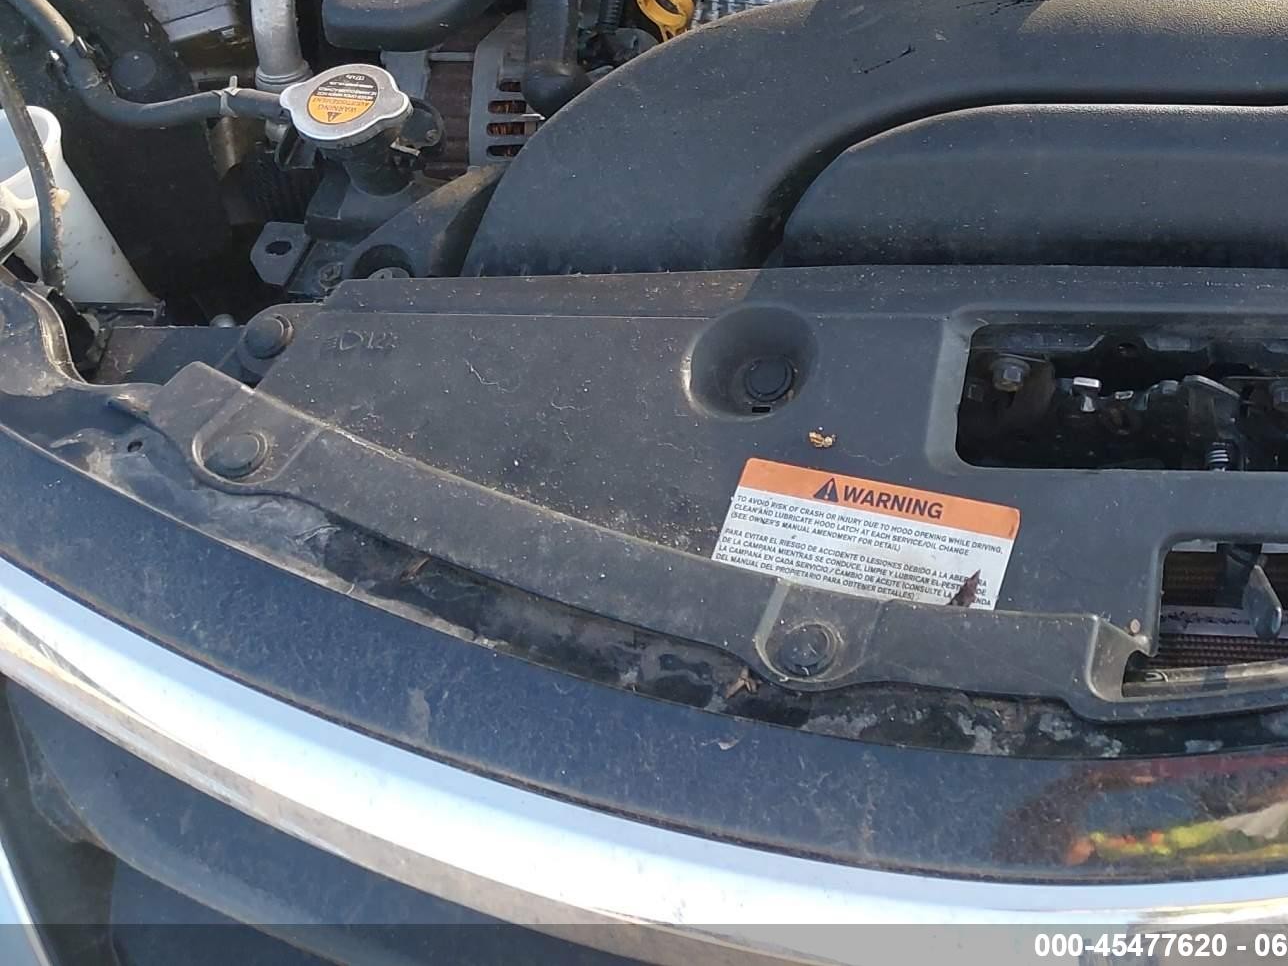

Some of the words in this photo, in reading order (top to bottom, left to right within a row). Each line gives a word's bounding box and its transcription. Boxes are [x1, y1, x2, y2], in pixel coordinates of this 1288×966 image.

[317, 104, 356, 112] WARNING
[748, 498, 769, 506] AVOID
[771, 502, 787, 510] RISK
[800, 508, 824, 517] CRASH
[838, 515, 861, 524] INJURY
[864, 520, 878, 528] DUE
[891, 525, 913, 535] HOOD
[914, 530, 947, 541] OPENING
[949, 537, 970, 546] WHILE
[844, 485, 944, 520] WARNING
[731, 512, 747, 520] (SEE
[782, 522, 810, 532] MANUAL
[813, 528, 856, 542] AMENDMENT
[858, 537, 872, 545] FOR
[874, 540, 901, 551] DETAIL)
[734, 503, 757, 513] CLEAN
[759, 508, 773, 516] AND
[775, 512, 812, 524] LUBRICATE
[814, 519, 835, 528] HOOD
[837, 524, 859, 533] LATCH
[871, 531, 890, 539] EACH
[893, 535, 936, 549] SERVICE/OIL
[939, 544, 968, 555] CHANGE
[716, 553, 728, 561] DEL
[730, 556, 759, 567] MANUAL
[761, 562, 773, 570] DEL
[775, 566, 821, 580] PROPIETARIO
[823, 575, 841, 584] PARA
[843, 579, 876, 591] OBTENER
[729, 547, 762, 558] CAMPANA
[775, 556, 794, 565] CADA
[796, 560, 828, 572] SERVICIO
[835, 568, 862, 579] CAMBIO
[865, 574, 874, 582] DE
[876, 577, 900, 587] ACEITE
[903, 582, 941, 595] (CONSULTE
[743, 541, 776, 552] CAMPANA
[778, 548, 813, 560] MIENTRAS
[864, 565, 887, 575] LIMPIE
[895, 571, 929, 584] LUBRICAR
[976, 587, 986, 595] DE
[745, 532, 768, 542] EVITAR
[780, 539, 805, 549] RIESGO
[818, 547, 857, 560] ACCIDENTE
[867, 557, 902, 569] LESIONES
[904, 564, 931, 575] DEBIDO
[950, 573, 987, 586] ABERRA
